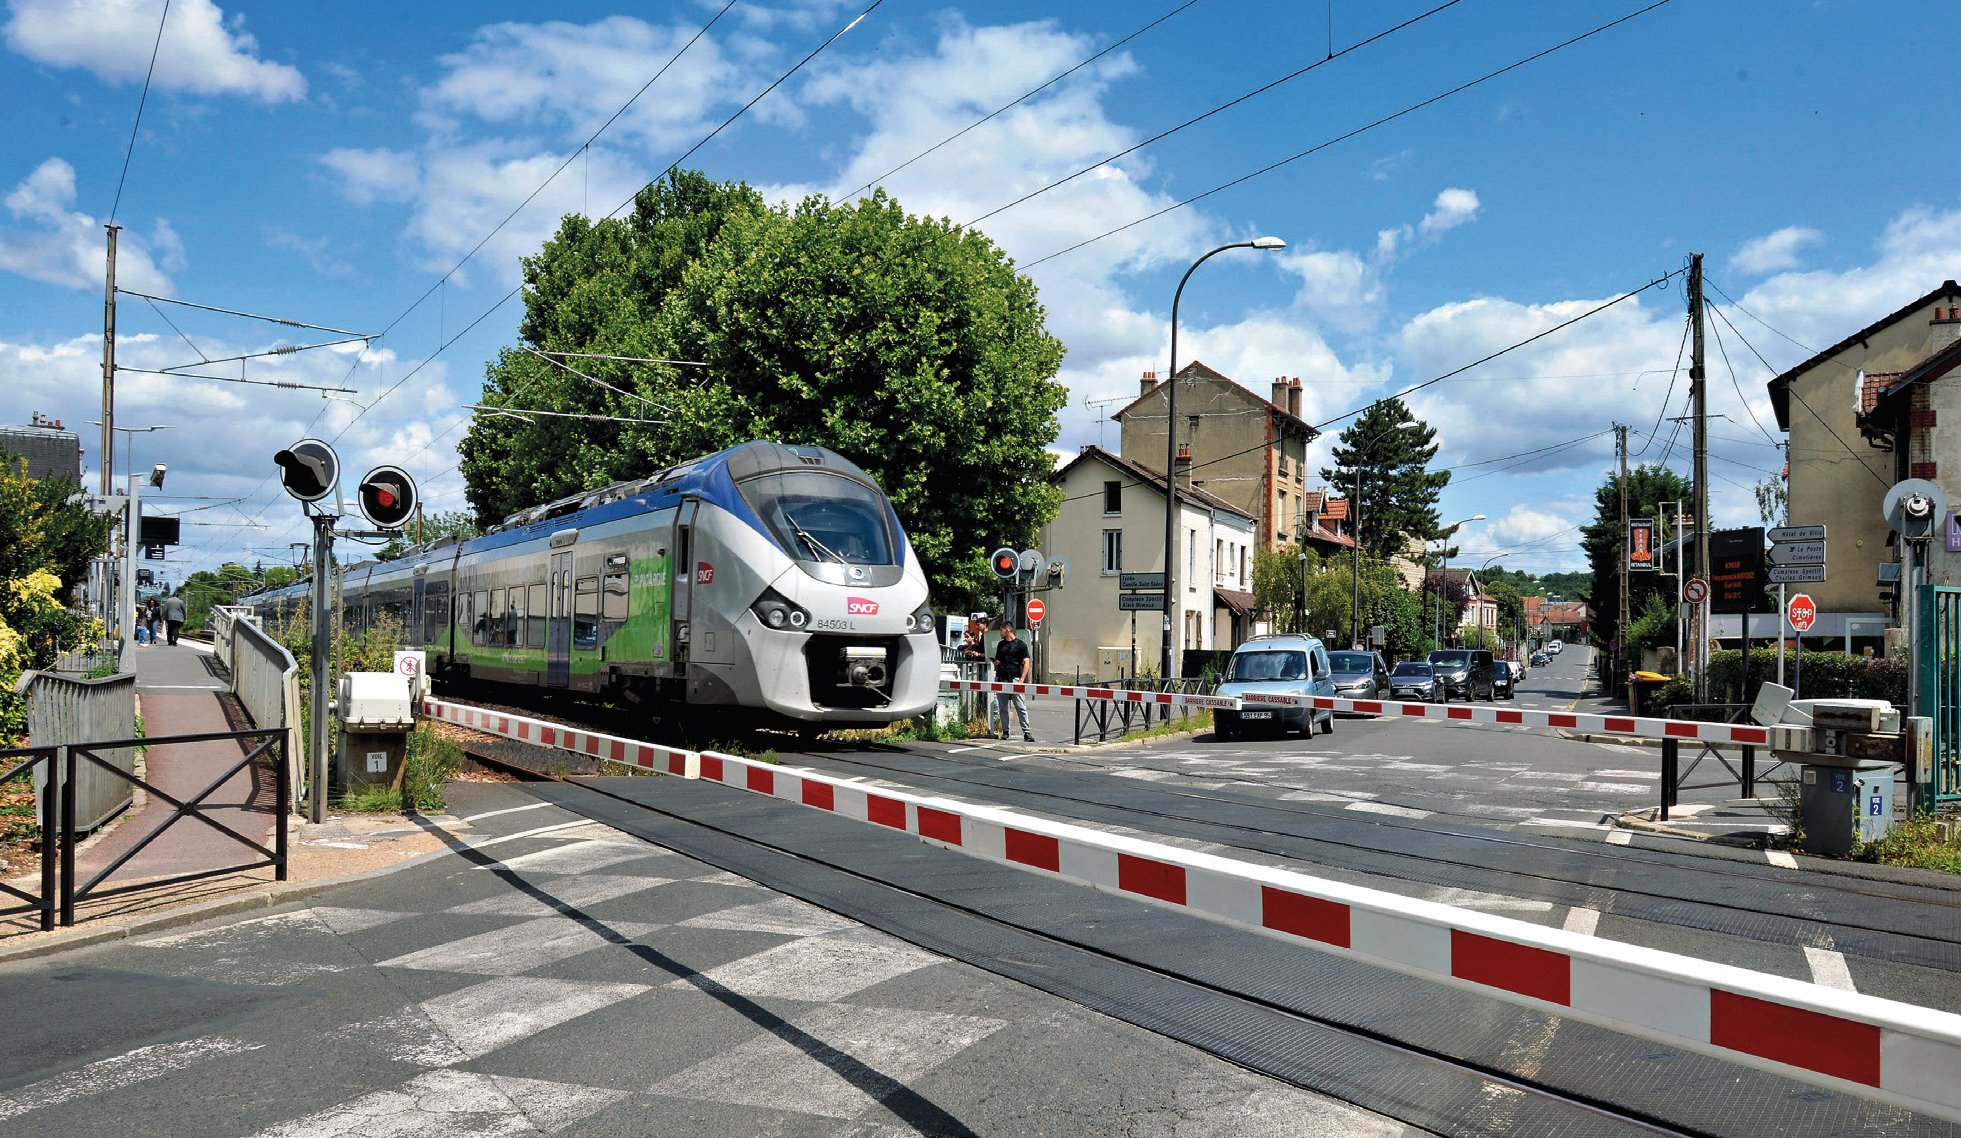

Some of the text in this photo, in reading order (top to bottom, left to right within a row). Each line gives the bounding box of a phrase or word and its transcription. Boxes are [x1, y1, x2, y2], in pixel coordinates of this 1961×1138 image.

[698, 569, 713, 581] SNCF
[848, 603, 878, 613] SNCF
[1791, 607, 1813, 619] STOP
[817, 619, 856, 630] 84503 L
[374, 760, 379, 769] 1
[1836, 781, 1844, 792] 2
[1873, 804, 1879, 814] 2
